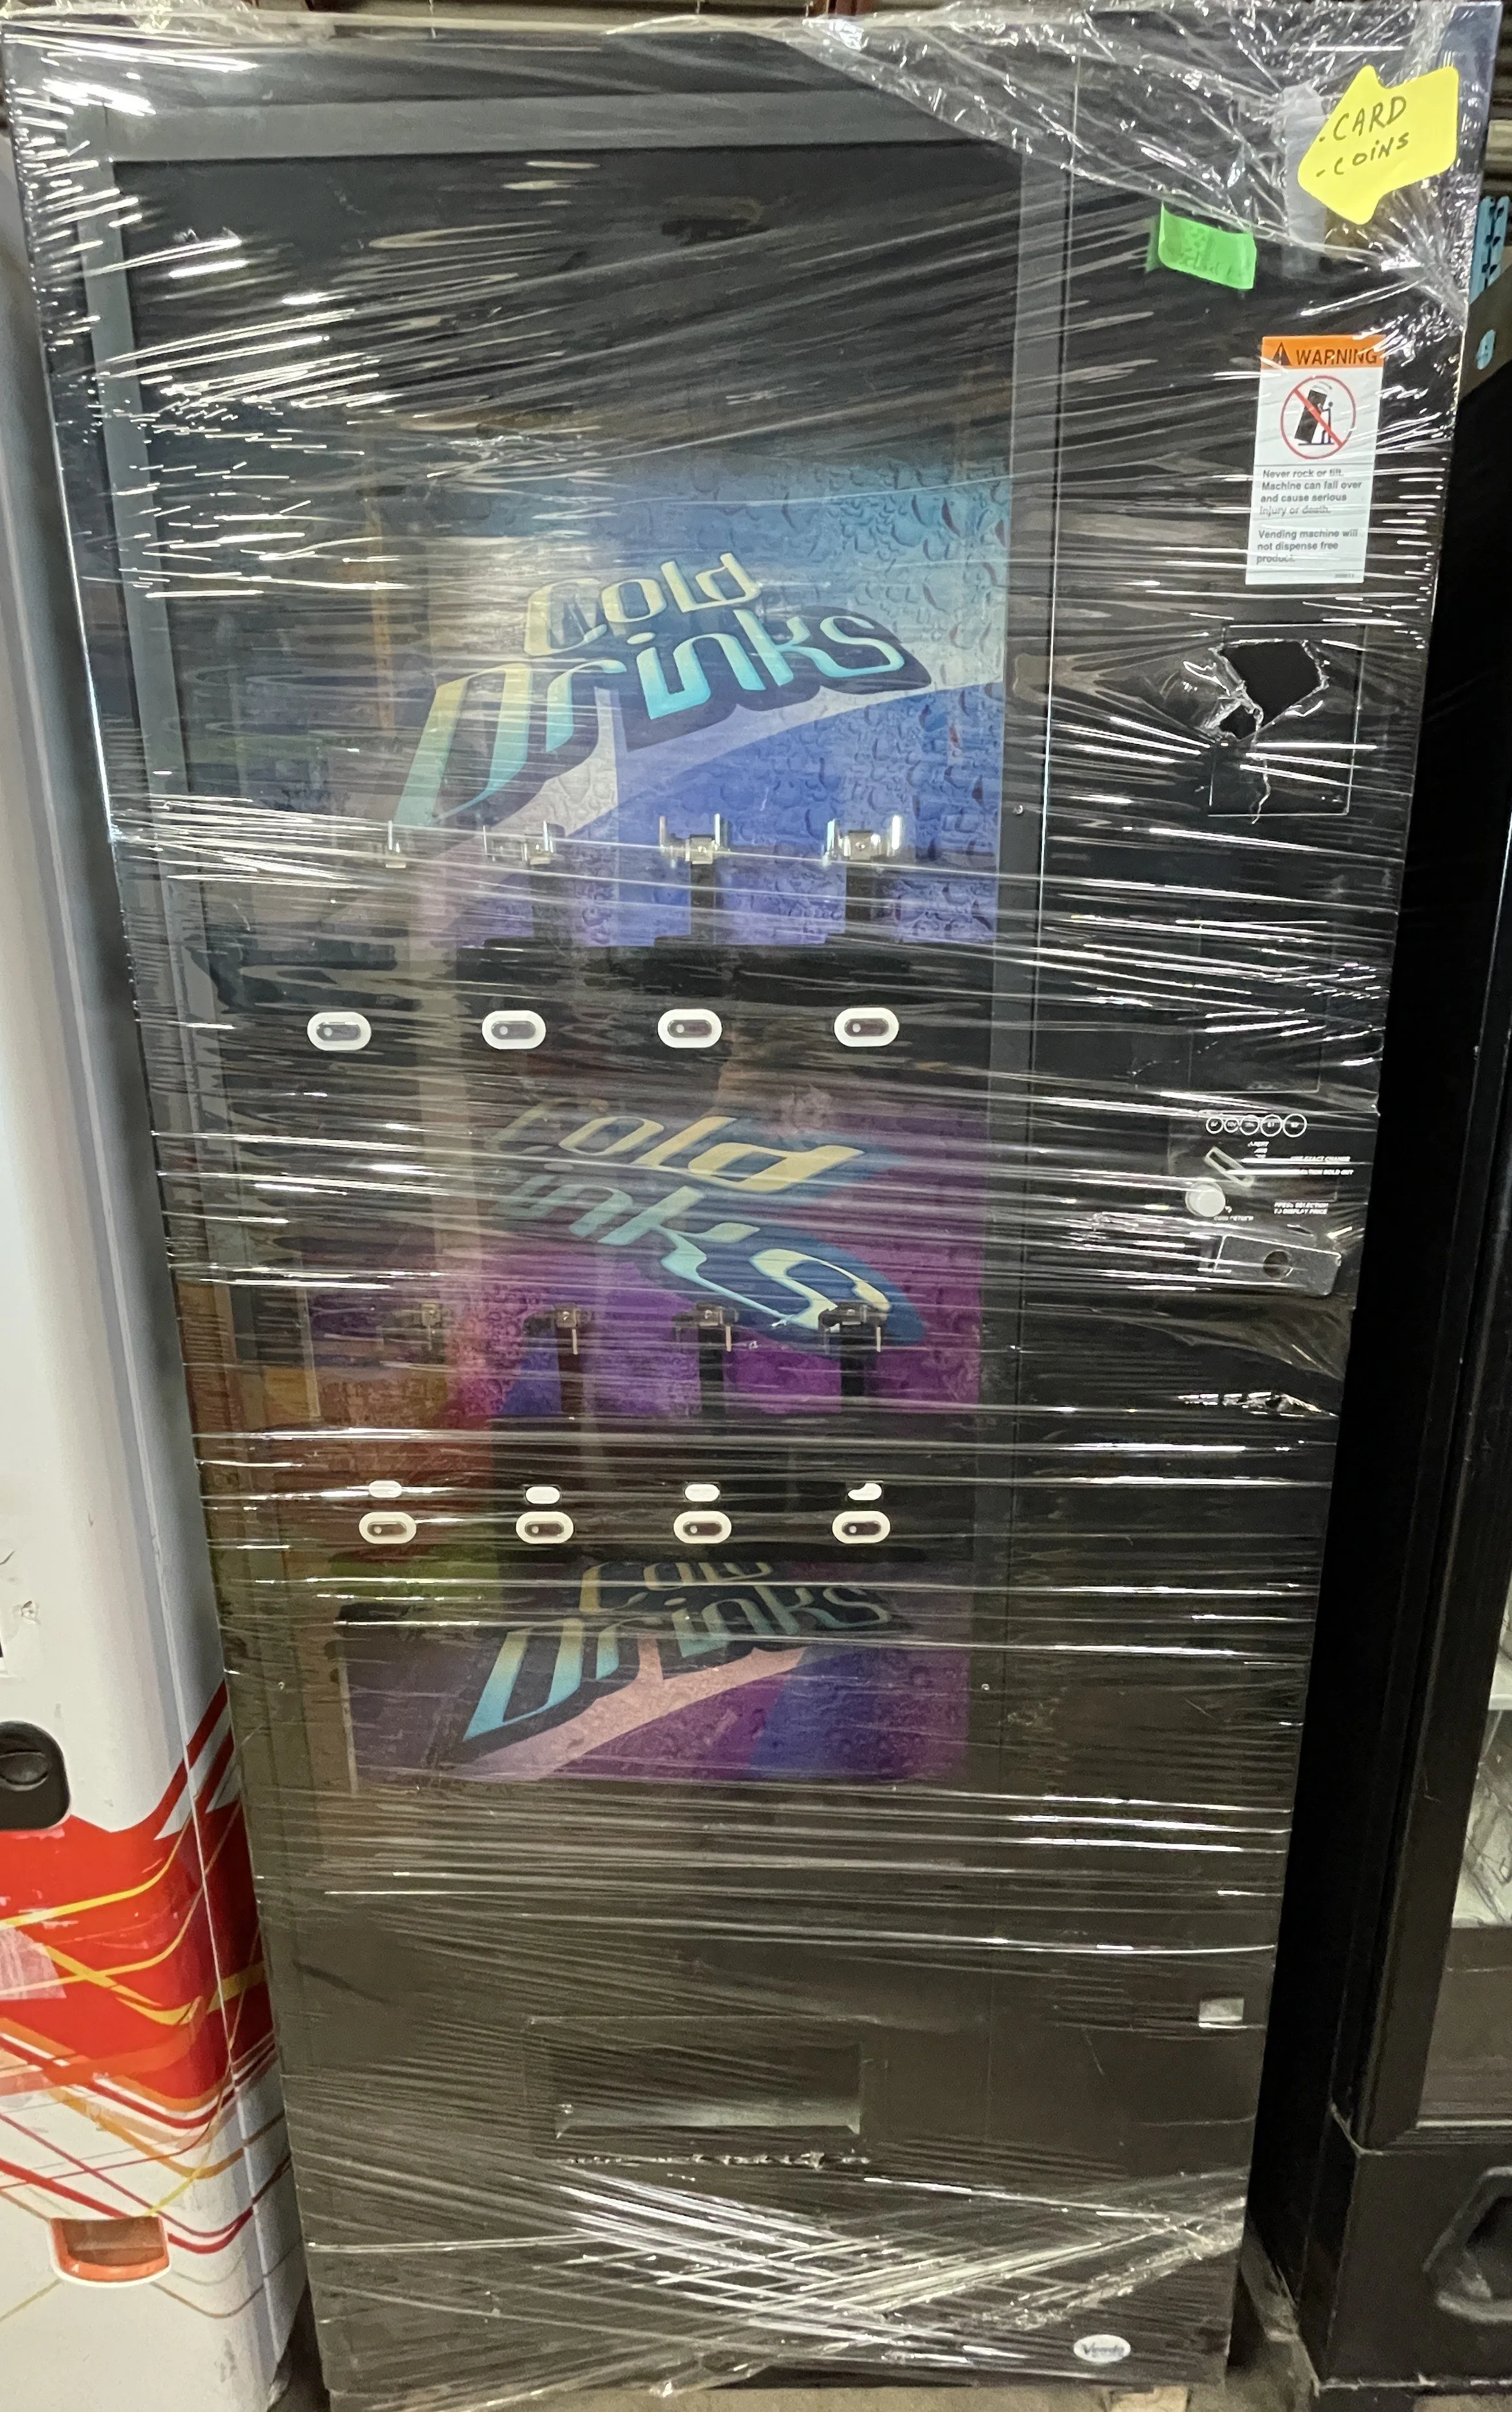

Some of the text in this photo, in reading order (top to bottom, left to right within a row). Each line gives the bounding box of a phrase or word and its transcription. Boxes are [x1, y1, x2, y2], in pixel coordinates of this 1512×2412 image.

[1296, 349, 1377, 365] WARNING
[1263, 469, 1290, 478] Never
[1293, 469, 1314, 478] rock
[1259, 530, 1297, 540] Vending
[1300, 529, 1339, 538] machine
[1275, 542, 1317, 551] dispense
[523, 552, 762, 657] Cold
[393, 609, 905, 828] Drinks
[464, 1584, 892, 1741] Drinks
